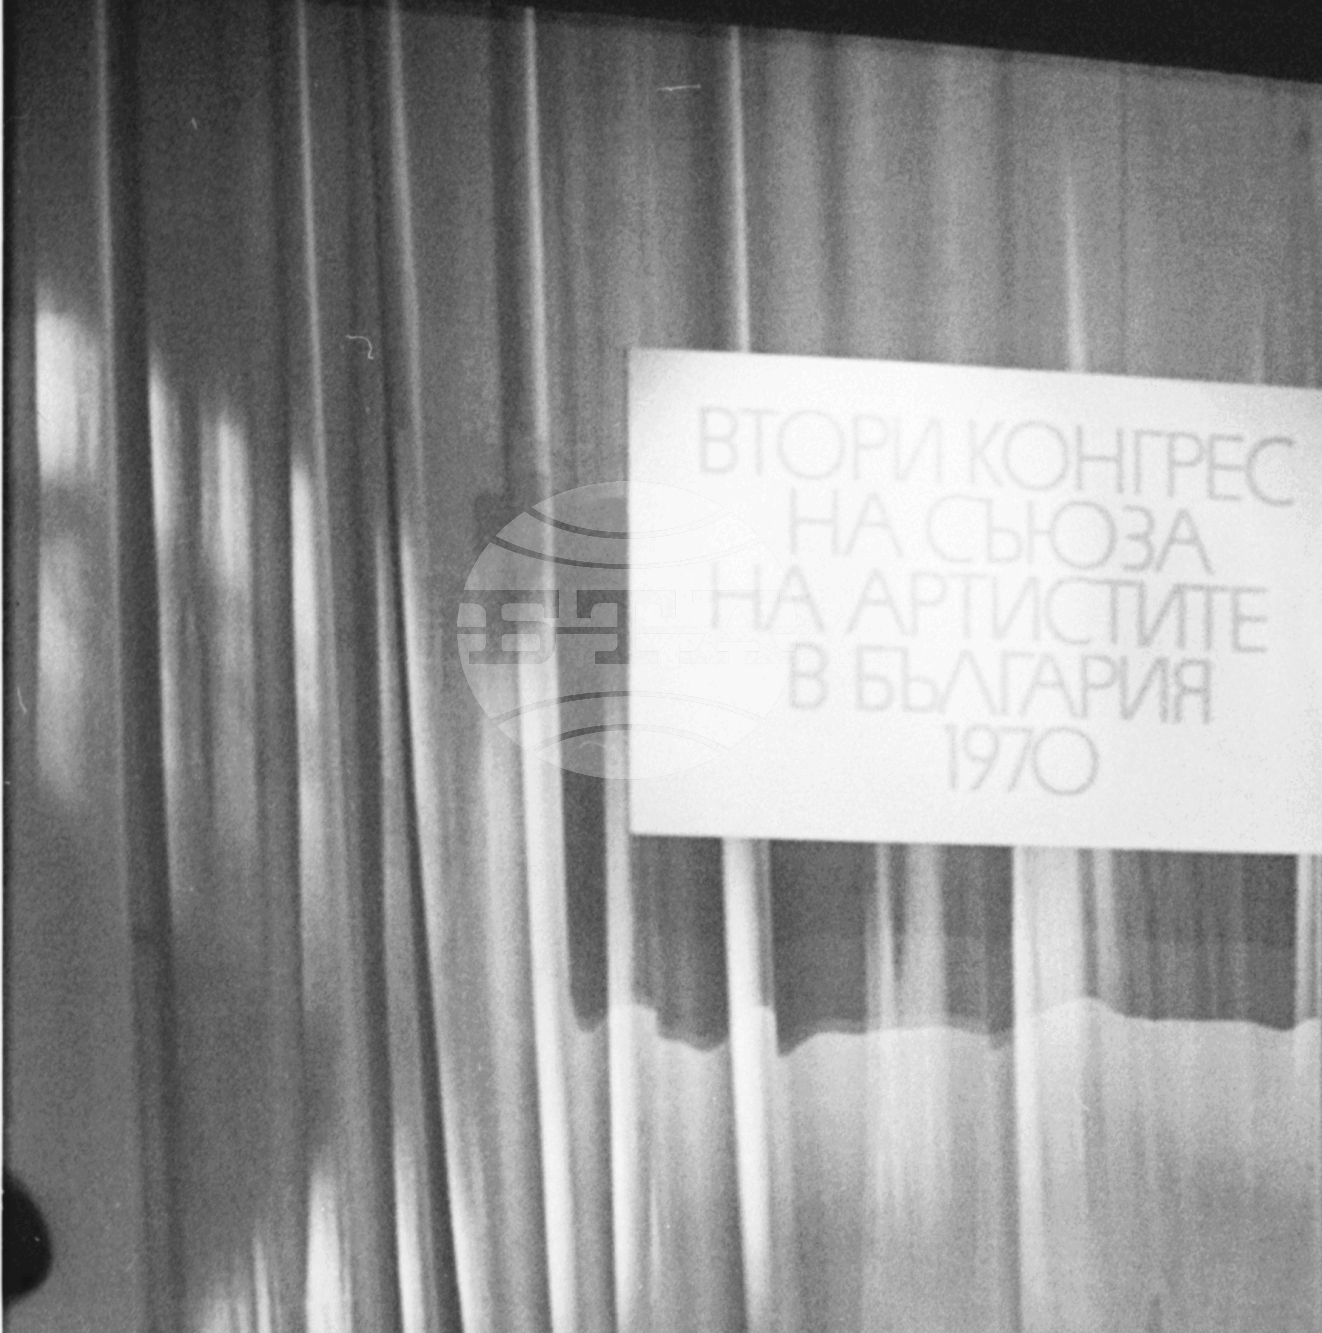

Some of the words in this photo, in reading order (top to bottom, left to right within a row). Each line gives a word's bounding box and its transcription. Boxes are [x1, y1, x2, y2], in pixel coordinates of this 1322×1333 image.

[698, 406, 944, 484] ВТОРИ
[968, 418, 1295, 507] КОНГРЕС
[788, 489, 903, 557] НА
[925, 493, 1215, 575] СЪЮЗА
[710, 564, 825, 632] НА
[846, 568, 1269, 654] АРТИСТИТЕ
[788, 642, 829, 711] В
[854, 644, 1213, 725] БЪЛГАРИЯ
[944, 722, 1100, 797] 1970
